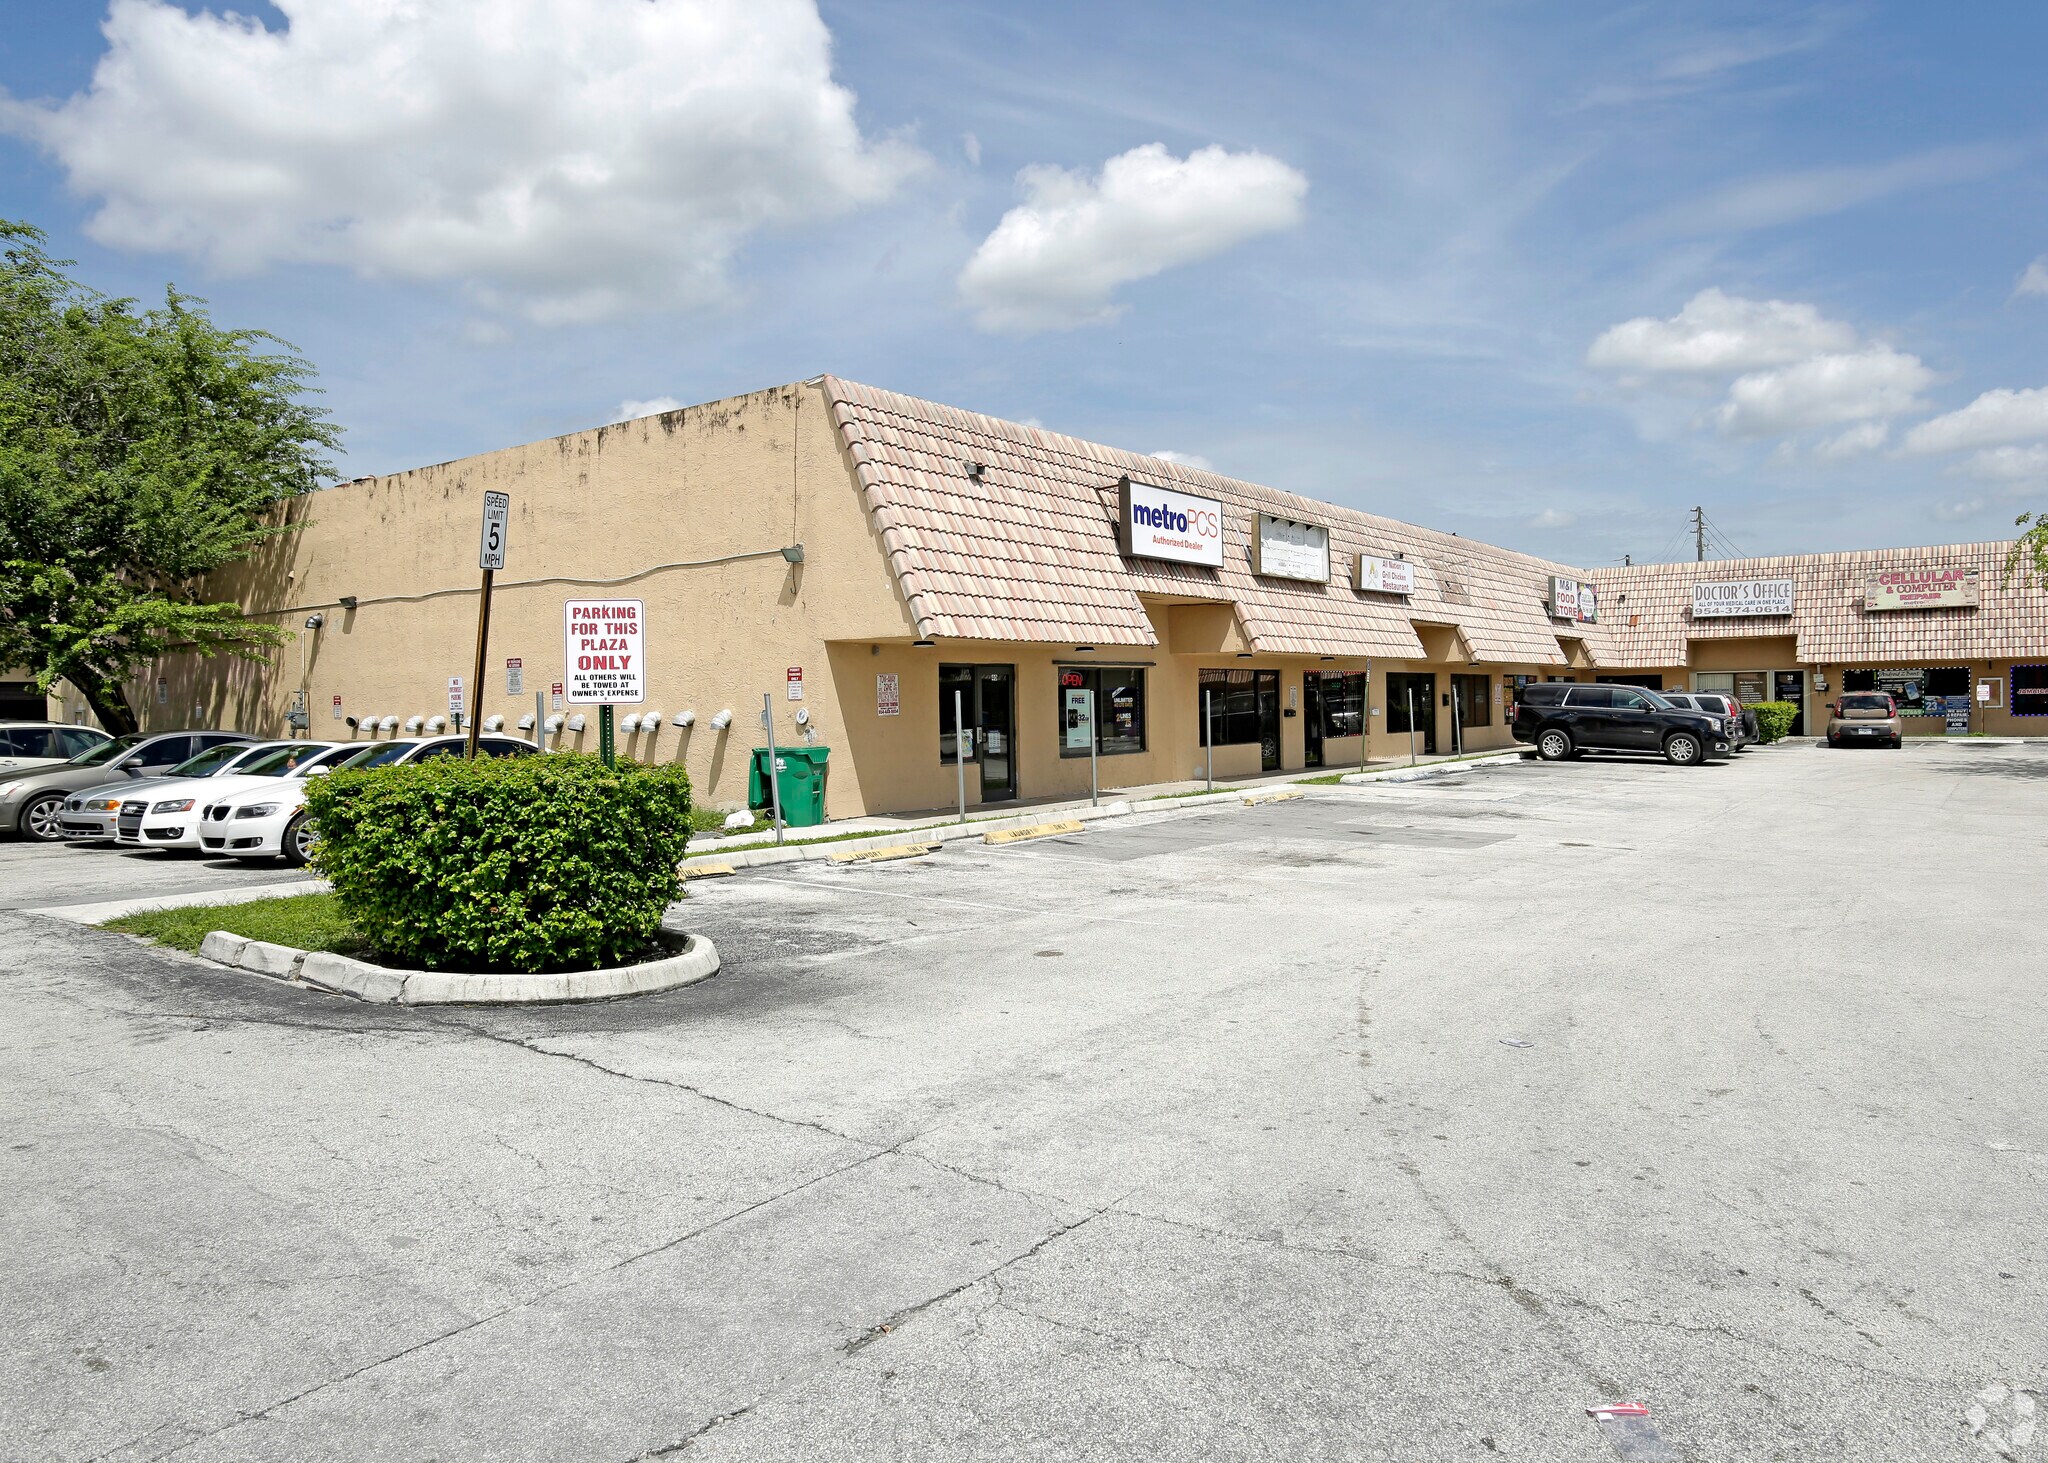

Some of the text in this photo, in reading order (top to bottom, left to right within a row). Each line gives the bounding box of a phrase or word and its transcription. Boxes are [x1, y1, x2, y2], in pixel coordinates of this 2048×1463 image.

[486, 496, 507, 509] SPEED
[487, 510, 504, 520] LIMIT
[1133, 503, 1218, 538] metroPCS
[488, 523, 500, 551] 5
[1152, 535, 1203, 551] Authorized Dealer
[484, 553, 501, 565] MPH
[1388, 560, 1405, 571] Nation's
[1381, 570, 1406, 581] Grill Chicken
[1879, 569, 1965, 585] CELLULAR
[1382, 580, 1409, 591] Restaurant
[1695, 582, 1790, 601] DOCTOR'S OFFICE
[1885, 586, 1894, 594] &
[1896, 582, 1958, 594] COMPUTER
[1556, 592, 1575, 604] FOOD
[572, 607, 636, 619] PARKING
[1555, 605, 1578, 617] STORE
[1695, 605, 1791, 615] 954-374-0614
[571, 622, 638, 635] FOR THIS
[581, 638, 628, 650] PLAZA
[578, 655, 632, 670] ONLY
[1062, 673, 1083, 686] OPEN
[1925, 701, 1938, 711] 23
[1116, 713, 1121, 722] 2
[1008, 828, 1034, 837] LAUNDRY
[850, 851, 883, 860] LAUNDRY
